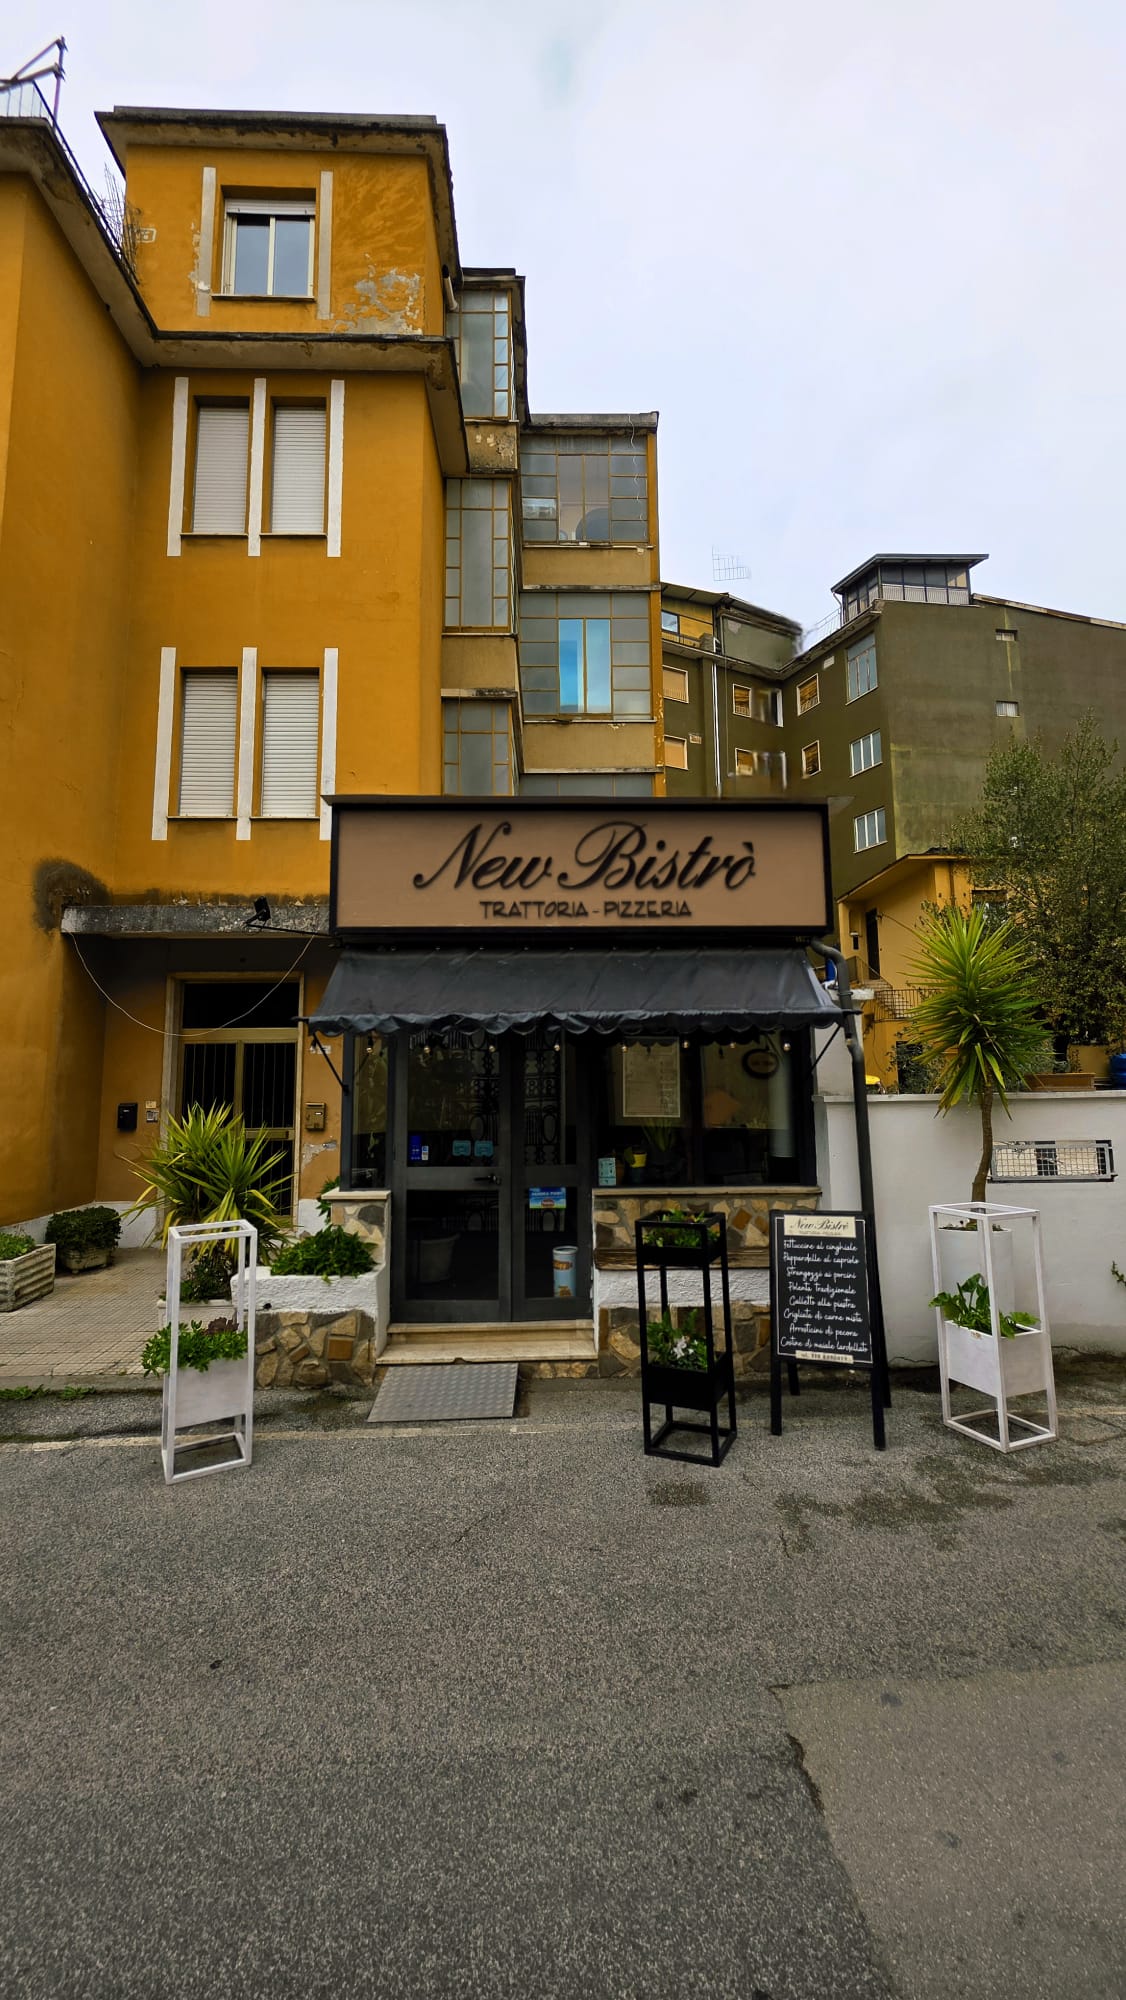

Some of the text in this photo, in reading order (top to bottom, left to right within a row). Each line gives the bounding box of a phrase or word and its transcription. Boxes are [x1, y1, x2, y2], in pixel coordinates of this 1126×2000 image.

[413, 820, 756, 890] New Bistrò
[479, 900, 589, 919] TRATTORIA
[604, 900, 692, 918] PIZZERIA
[789, 1217, 814, 1229] New
[816, 1240, 825, 1250] al
[825, 1241, 858, 1255] cinghiale
[823, 1253, 832, 1263] al
[833, 1255, 860, 1269] capriolo
[833, 1272, 857, 1284] porcini
[788, 1281, 813, 1292] Polenta
[817, 1296, 832, 1307] alla
[833, 1296, 857, 1312] piastra
[814, 1310, 823, 1321] di
[845, 1311, 864, 1323] mista
[789, 1322, 858, 1341] Arrosticini di pecora
[780, 1335, 804, 1347] Costine
[804, 1338, 813, 1349] di
[813, 1340, 836, 1350] maiale
